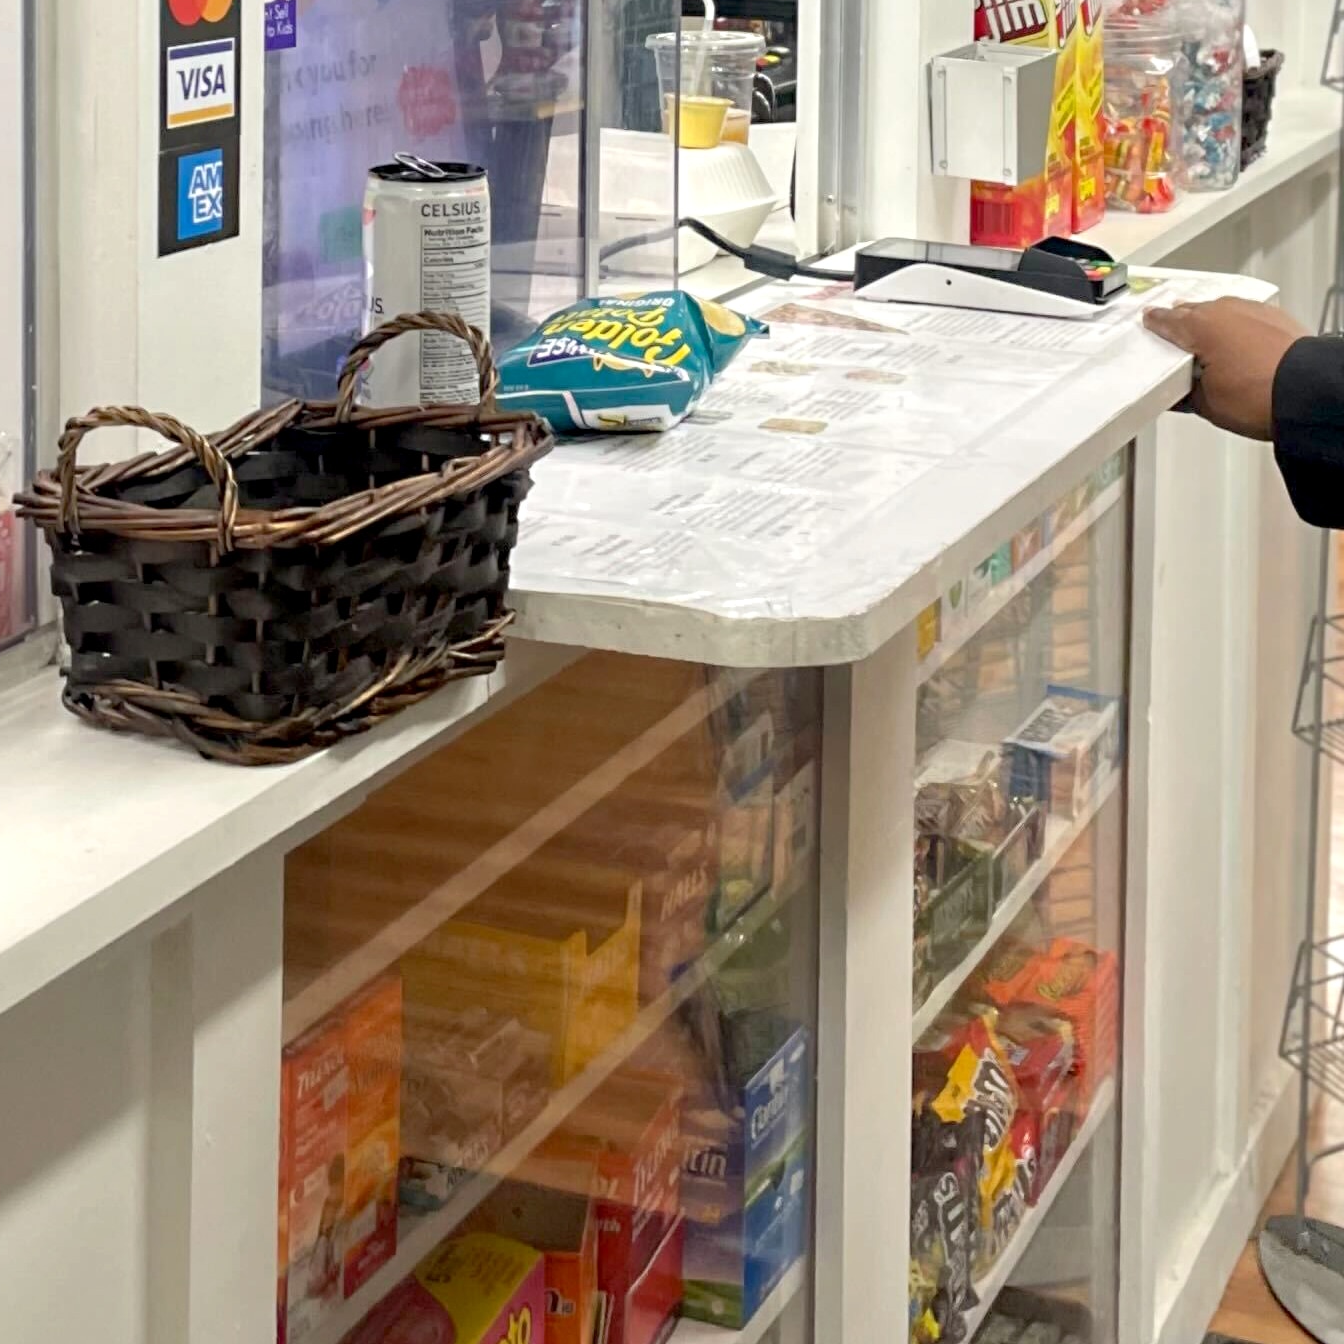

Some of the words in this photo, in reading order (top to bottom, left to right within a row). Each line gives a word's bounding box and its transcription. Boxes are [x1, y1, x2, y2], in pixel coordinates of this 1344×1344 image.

[176, 64, 226, 100] VISA
[189, 160, 224, 199] AM
[192, 193, 224, 224] EX
[420, 201, 482, 218] CELSIUS
[423, 226, 464, 238] Nutrition
[465, 224, 485, 236] Facts
[598, 296, 675, 308] ORIGINAL
